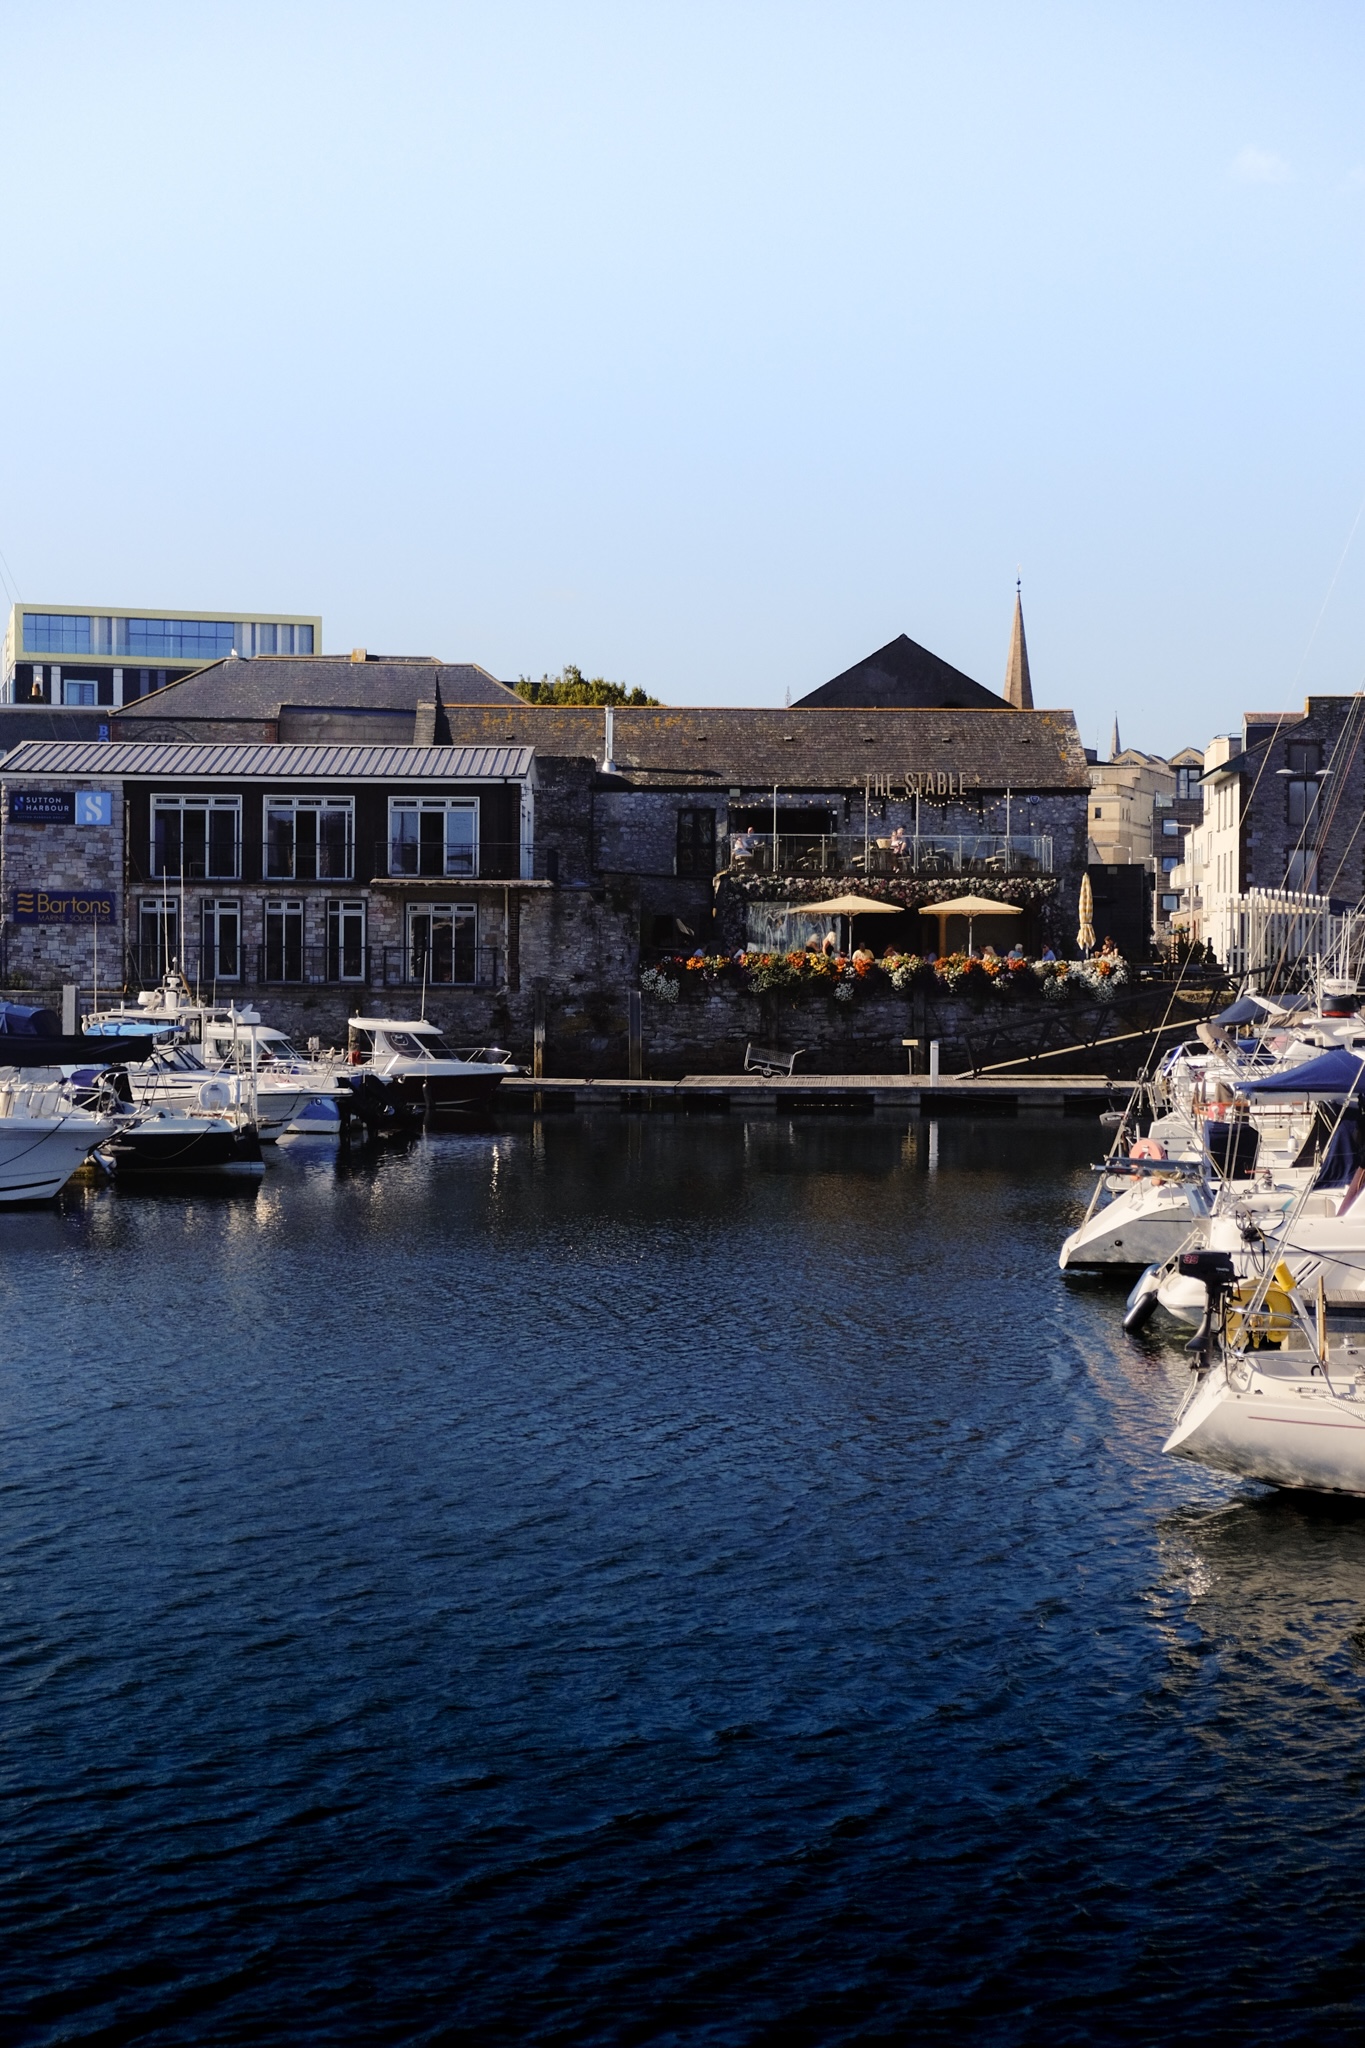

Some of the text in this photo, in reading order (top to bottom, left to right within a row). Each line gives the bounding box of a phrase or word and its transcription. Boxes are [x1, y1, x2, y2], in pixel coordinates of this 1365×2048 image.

[864, 772, 967, 796] THE STABLE
[26, 796, 62, 804] SUTTON
[26, 804, 70, 812] HARBOUR
[37, 893, 111, 914] Bartons
[38, 914, 111, 923] MARINE SOLICITORS
